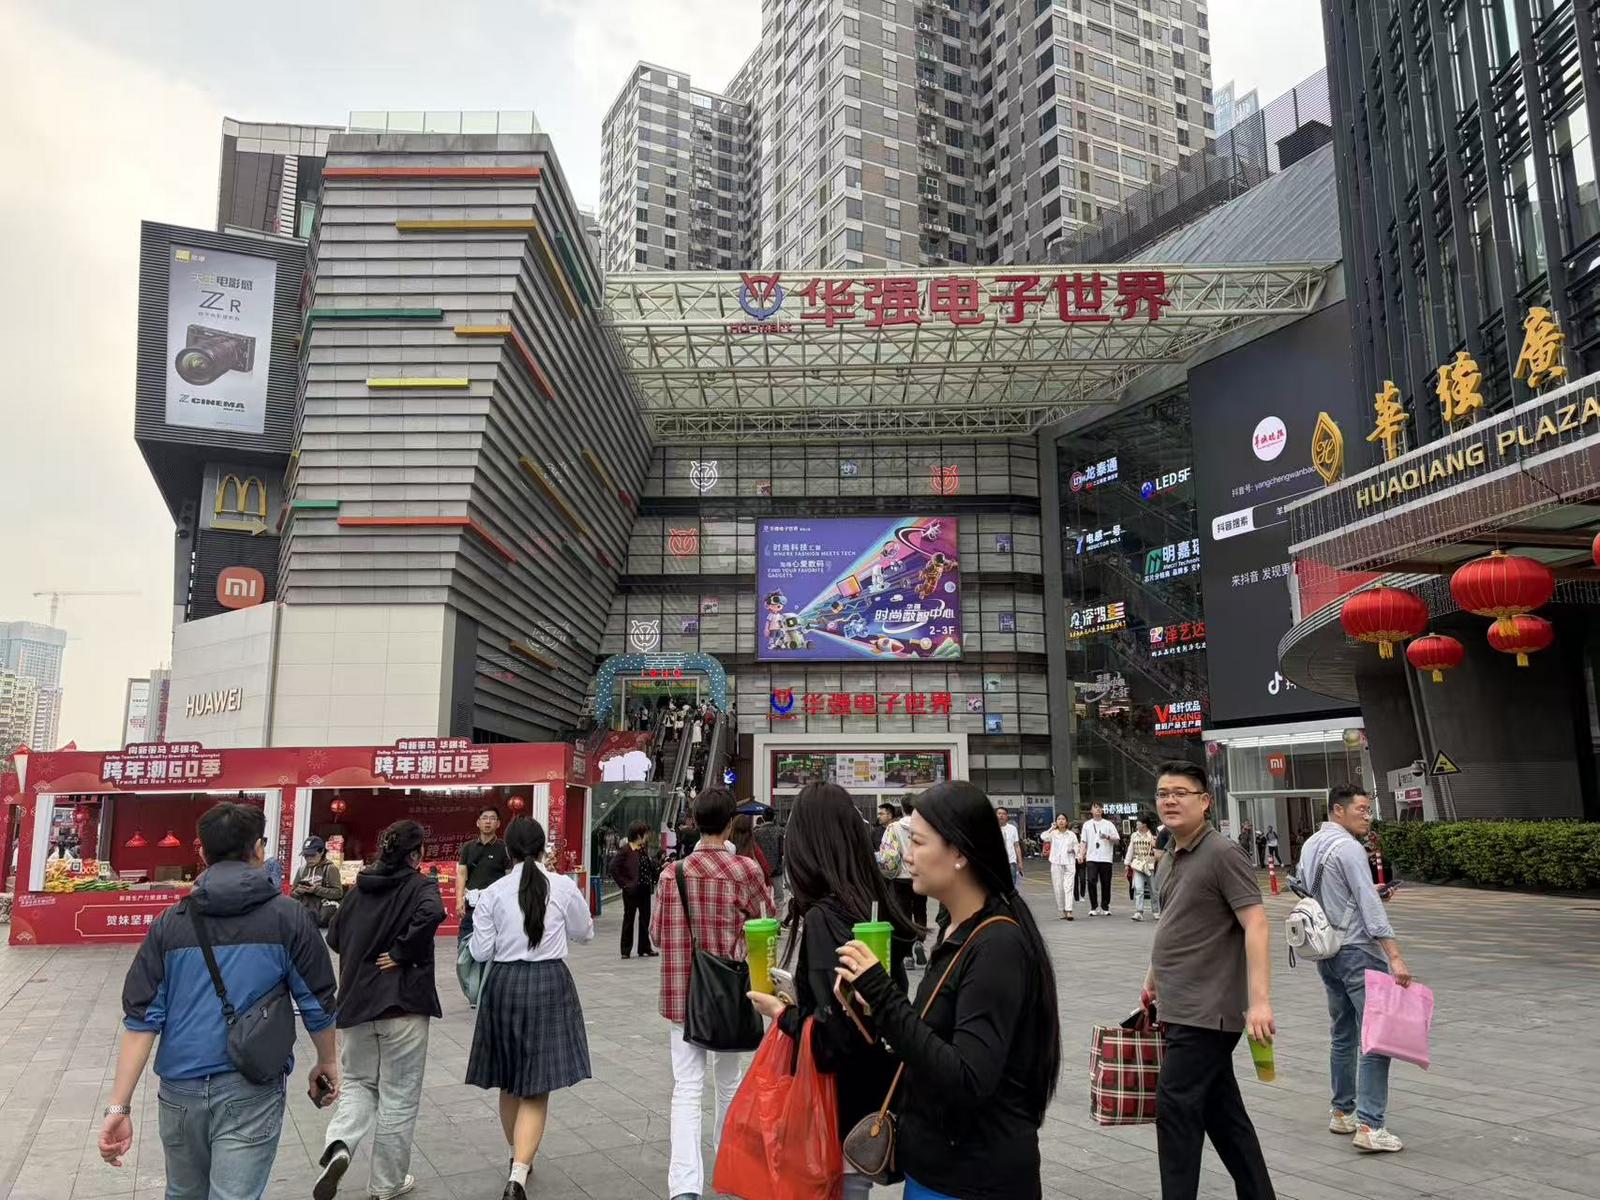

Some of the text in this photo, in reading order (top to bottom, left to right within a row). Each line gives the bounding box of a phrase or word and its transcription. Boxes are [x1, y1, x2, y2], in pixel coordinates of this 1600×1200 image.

[230, 299, 241, 313] R
[799, 271, 1171, 328] 华强电子世界
[191, 397, 245, 409] CINEMA
[1356, 396, 1600, 510] HUAQIANG PLAZA
[1216, 514, 1249, 534] 抖音搜索
[1231, 569, 1258, 587] 来抖音
[929, 625, 955, 635] 2-3F
[185, 687, 243, 718] HUAWEI
[801, 691, 953, 716] 华强电子世界
